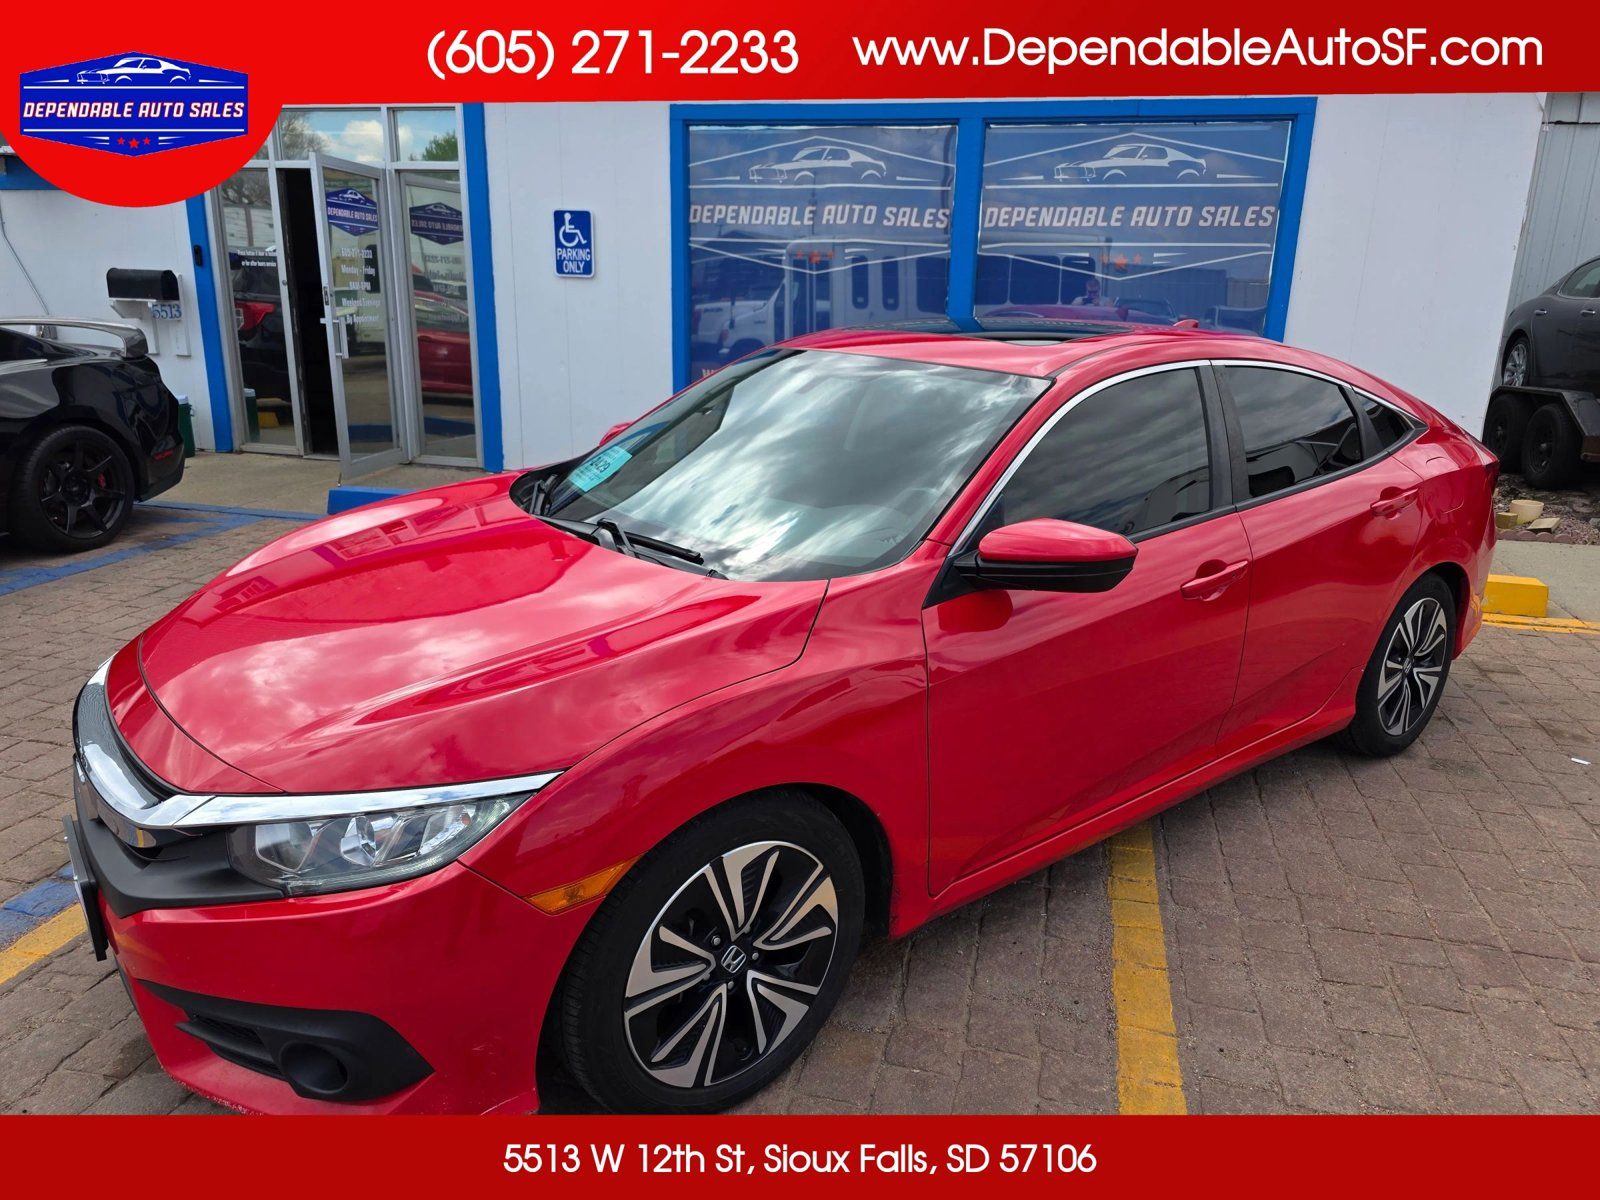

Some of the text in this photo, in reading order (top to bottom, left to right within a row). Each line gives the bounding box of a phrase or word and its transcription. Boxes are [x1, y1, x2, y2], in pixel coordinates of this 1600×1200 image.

[327, 206, 378, 222] DEPENDABLE AUTO SALES
[688, 204, 950, 229] DEPENDABLE AUTO SALES
[984, 205, 1276, 228] DEPENDABLE AUTO SALES
[557, 248, 591, 261] PARKING
[341, 264, 358, 276] Monday
[363, 265, 376, 277] Friday
[563, 260, 585, 273] ONLY
[151, 303, 182, 320] 5513
